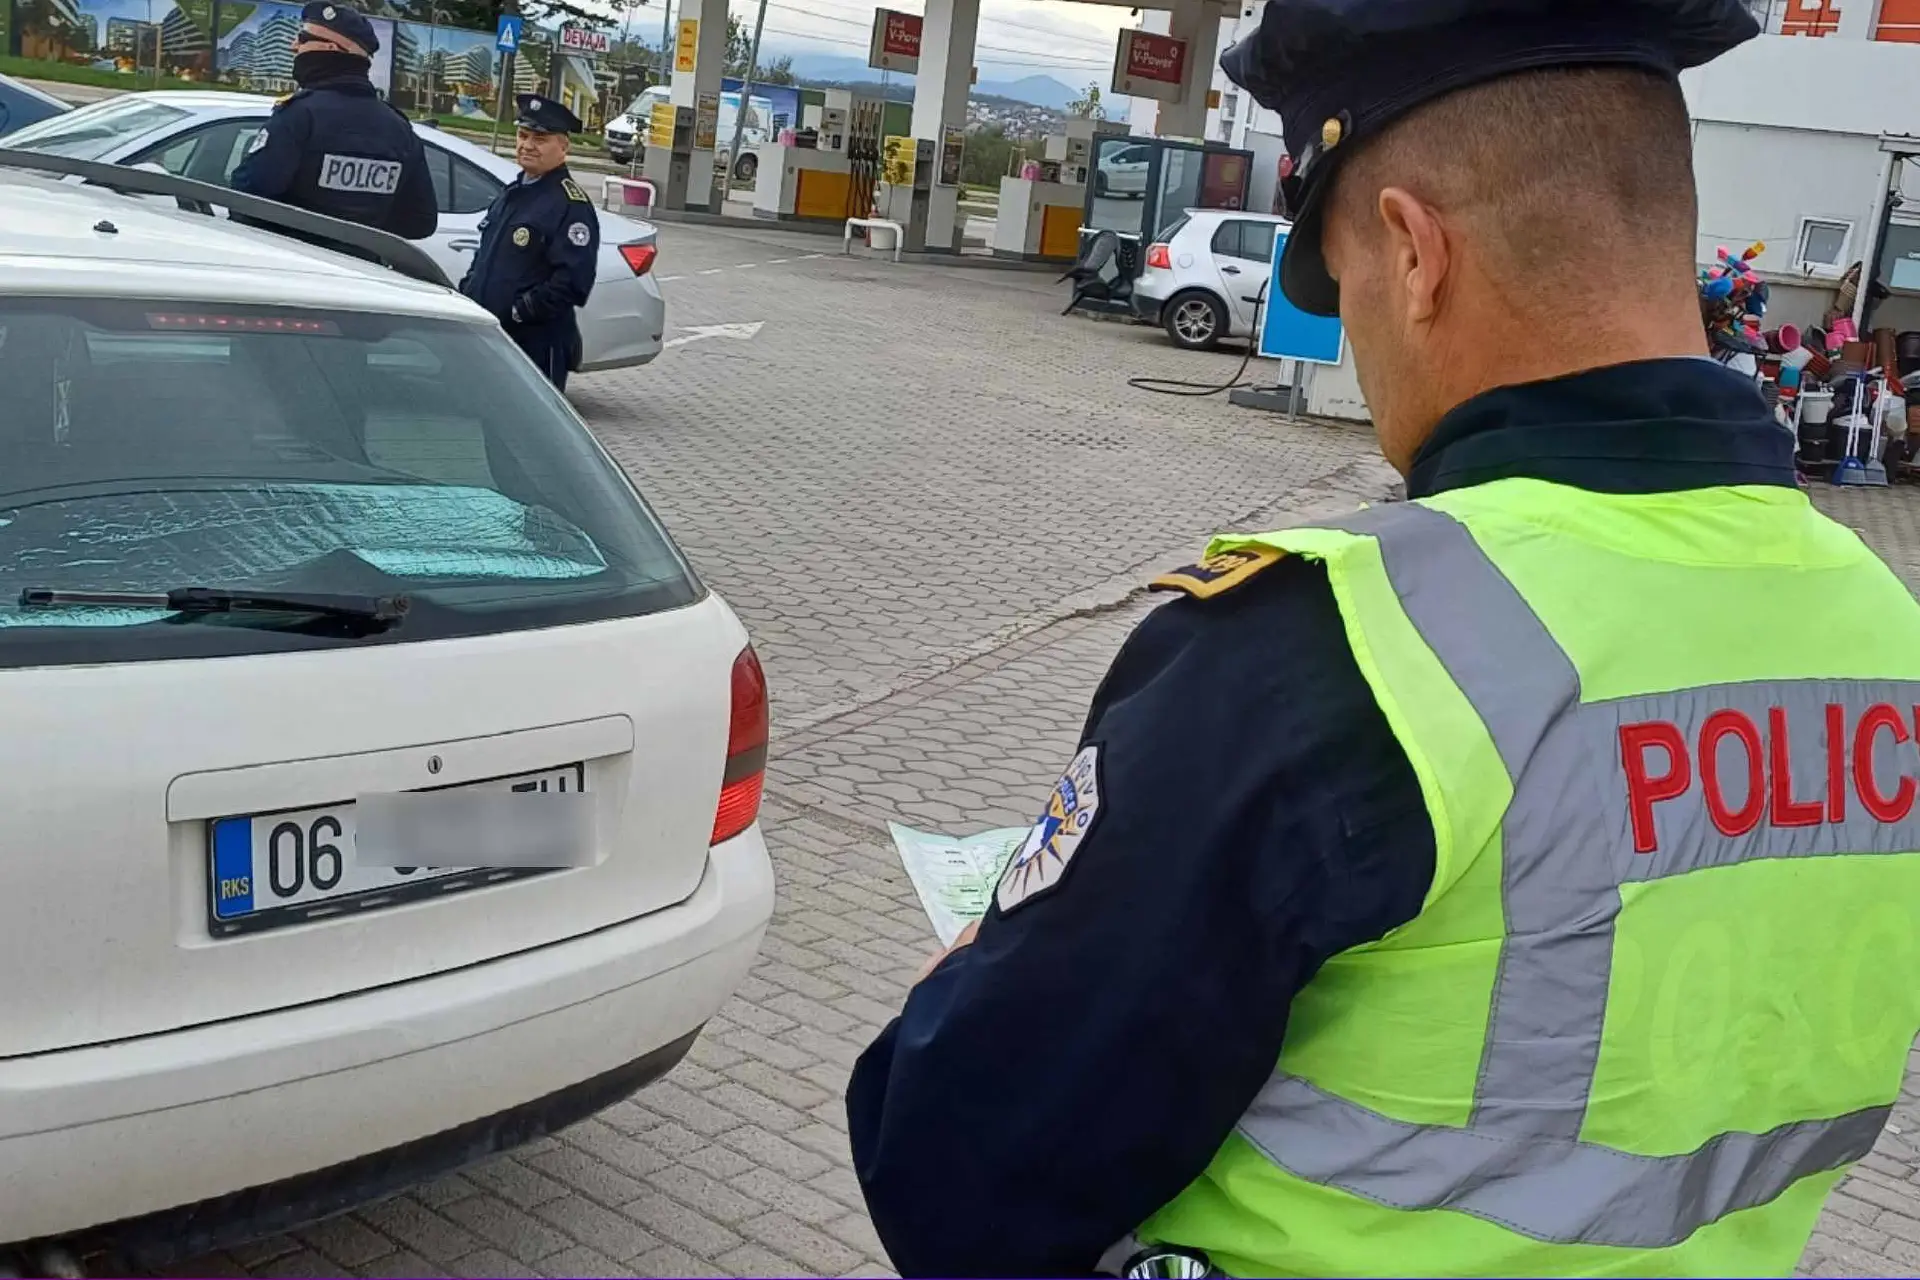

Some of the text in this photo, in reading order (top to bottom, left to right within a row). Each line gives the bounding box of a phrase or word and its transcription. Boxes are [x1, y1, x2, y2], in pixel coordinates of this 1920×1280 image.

[564, 28, 607, 51] DEVAJA
[325, 159, 399, 191] POLICE
[1618, 702, 1920, 854] POLIC
[221, 815, 343, 899] RKS 06
